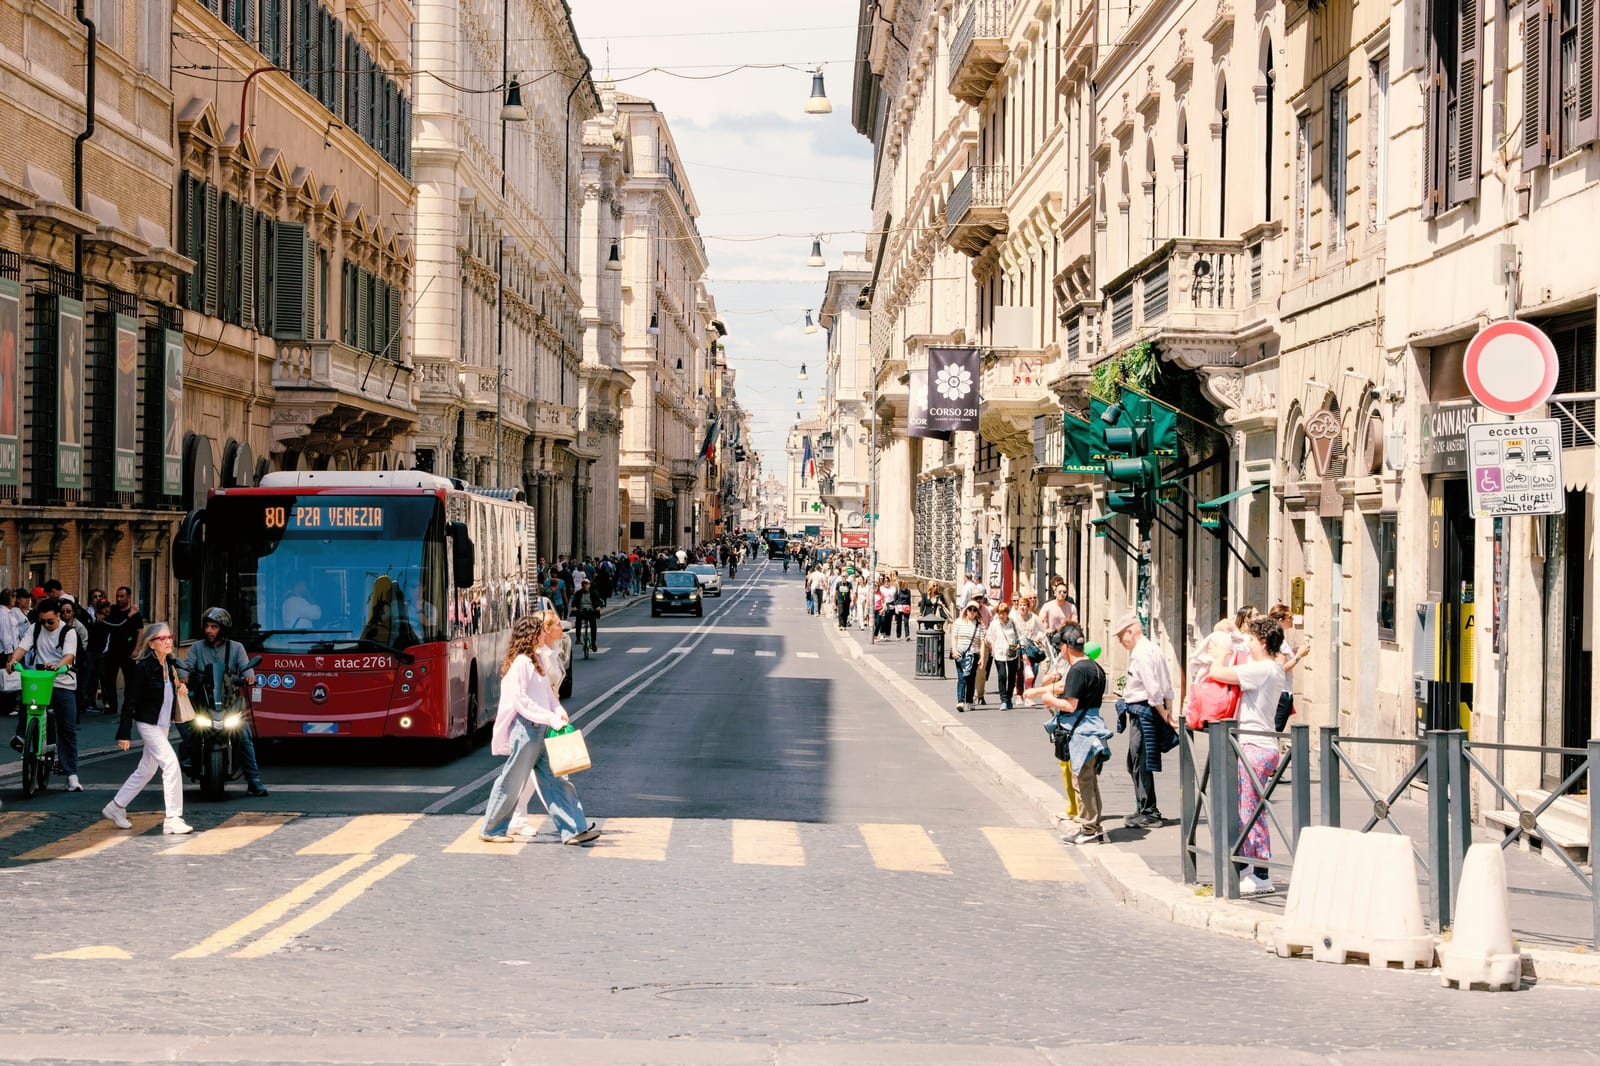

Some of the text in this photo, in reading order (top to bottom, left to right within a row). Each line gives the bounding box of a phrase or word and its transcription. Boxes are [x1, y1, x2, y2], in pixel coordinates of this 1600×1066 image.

[929, 407, 978, 418] CORSO 281
[1431, 407, 1475, 438] CANNABIS
[1488, 425, 1538, 437] eccetto
[60, 448, 80, 475] MUNCH
[1520, 491, 1553, 502] diretti
[1431, 496, 1443, 517] ATM
[265, 506, 382, 528] 80 PZA VENEZIA
[274, 659, 305, 669] ROMA
[334, 656, 392, 669] atac 2761
